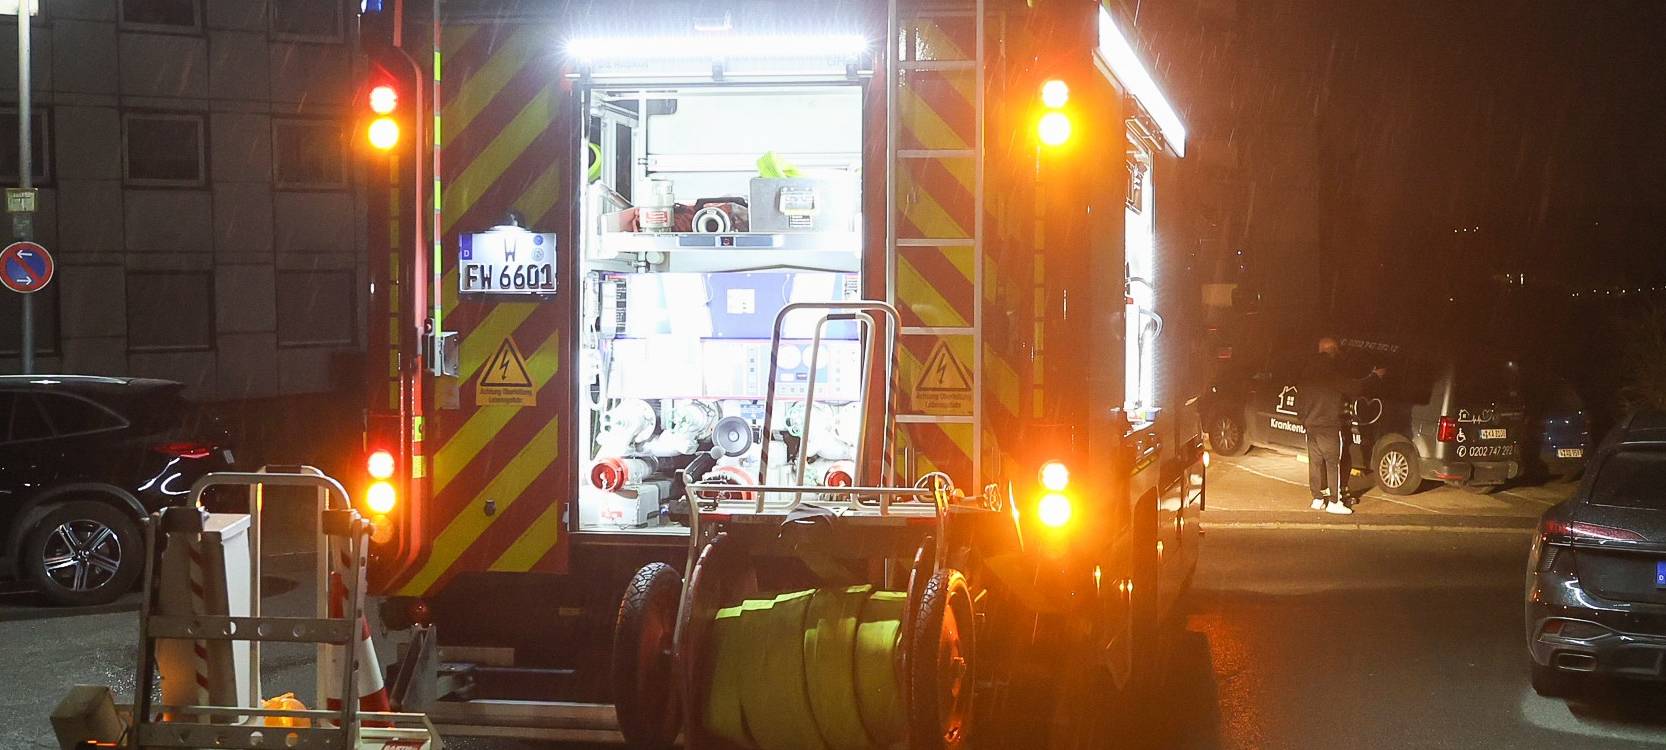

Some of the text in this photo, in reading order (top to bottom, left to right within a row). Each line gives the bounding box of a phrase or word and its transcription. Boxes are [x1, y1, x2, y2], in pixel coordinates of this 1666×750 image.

[463, 249, 470, 257] D
[504, 238, 517, 262] W
[464, 264, 555, 290] FW 6601
[1270, 417, 1306, 434] Krankent
[1469, 446, 1488, 457] 0202
[1489, 446, 1501, 456] 747
